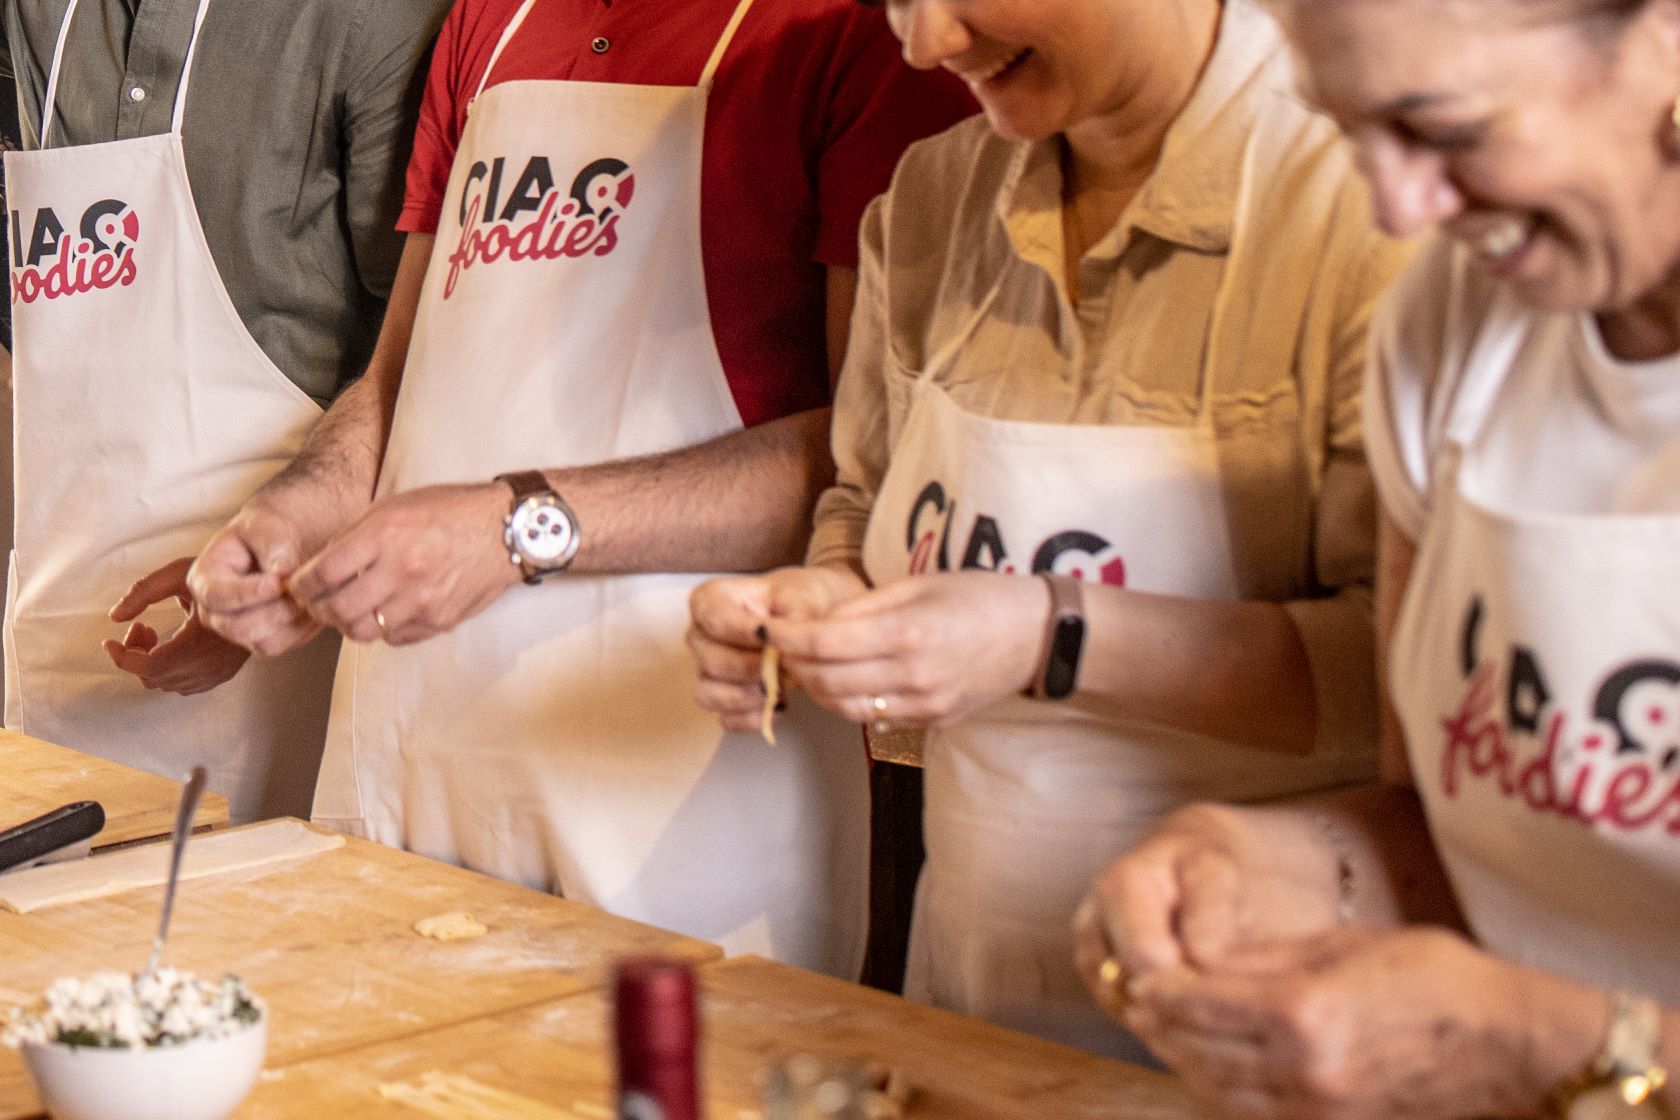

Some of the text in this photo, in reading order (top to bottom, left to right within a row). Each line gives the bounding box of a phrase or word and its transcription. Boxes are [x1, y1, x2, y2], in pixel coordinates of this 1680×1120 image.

[460, 155, 635, 227] CIAO
[11, 198, 140, 267] IAO
[443, 191, 620, 301] foodies
